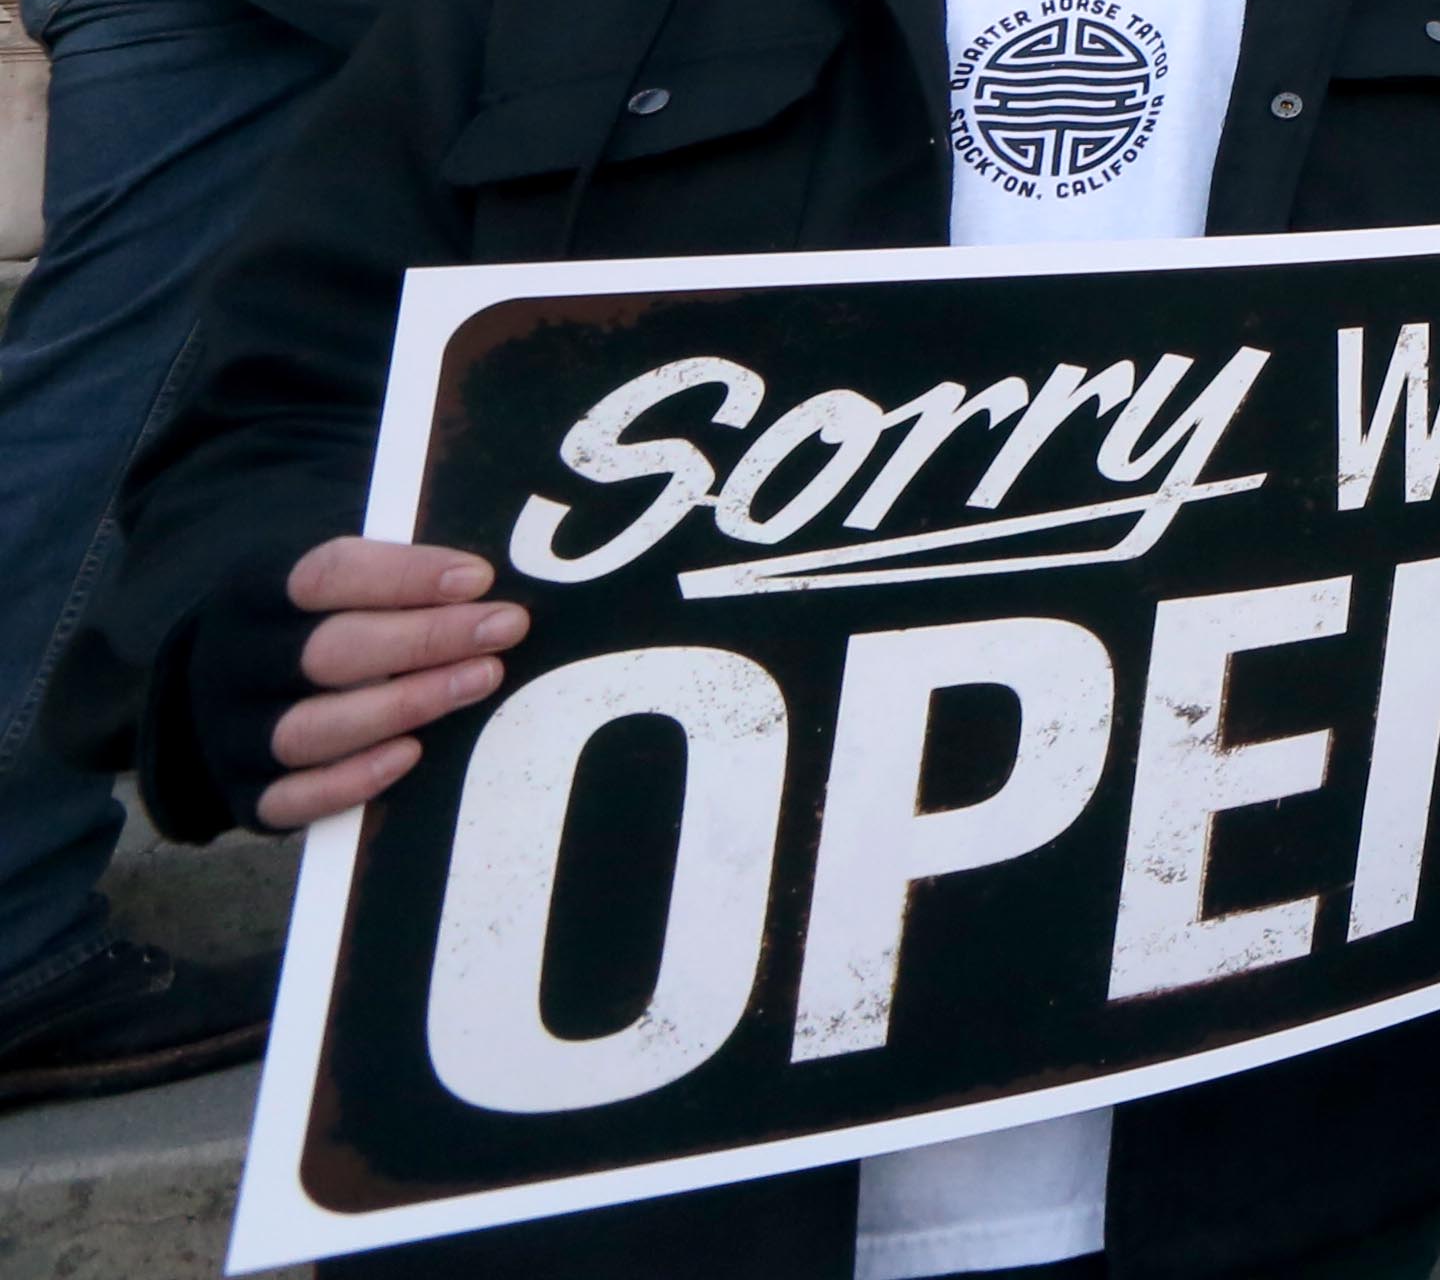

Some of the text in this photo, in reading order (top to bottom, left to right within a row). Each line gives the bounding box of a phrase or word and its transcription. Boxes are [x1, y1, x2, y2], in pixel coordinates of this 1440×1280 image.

[951, 10, 1032, 91] QUARTER
[1125, 14, 1168, 79] TATTOO
[1056, 94, 1165, 199] CALIFORNIA
[508, 345, 1270, 601] Sorry
